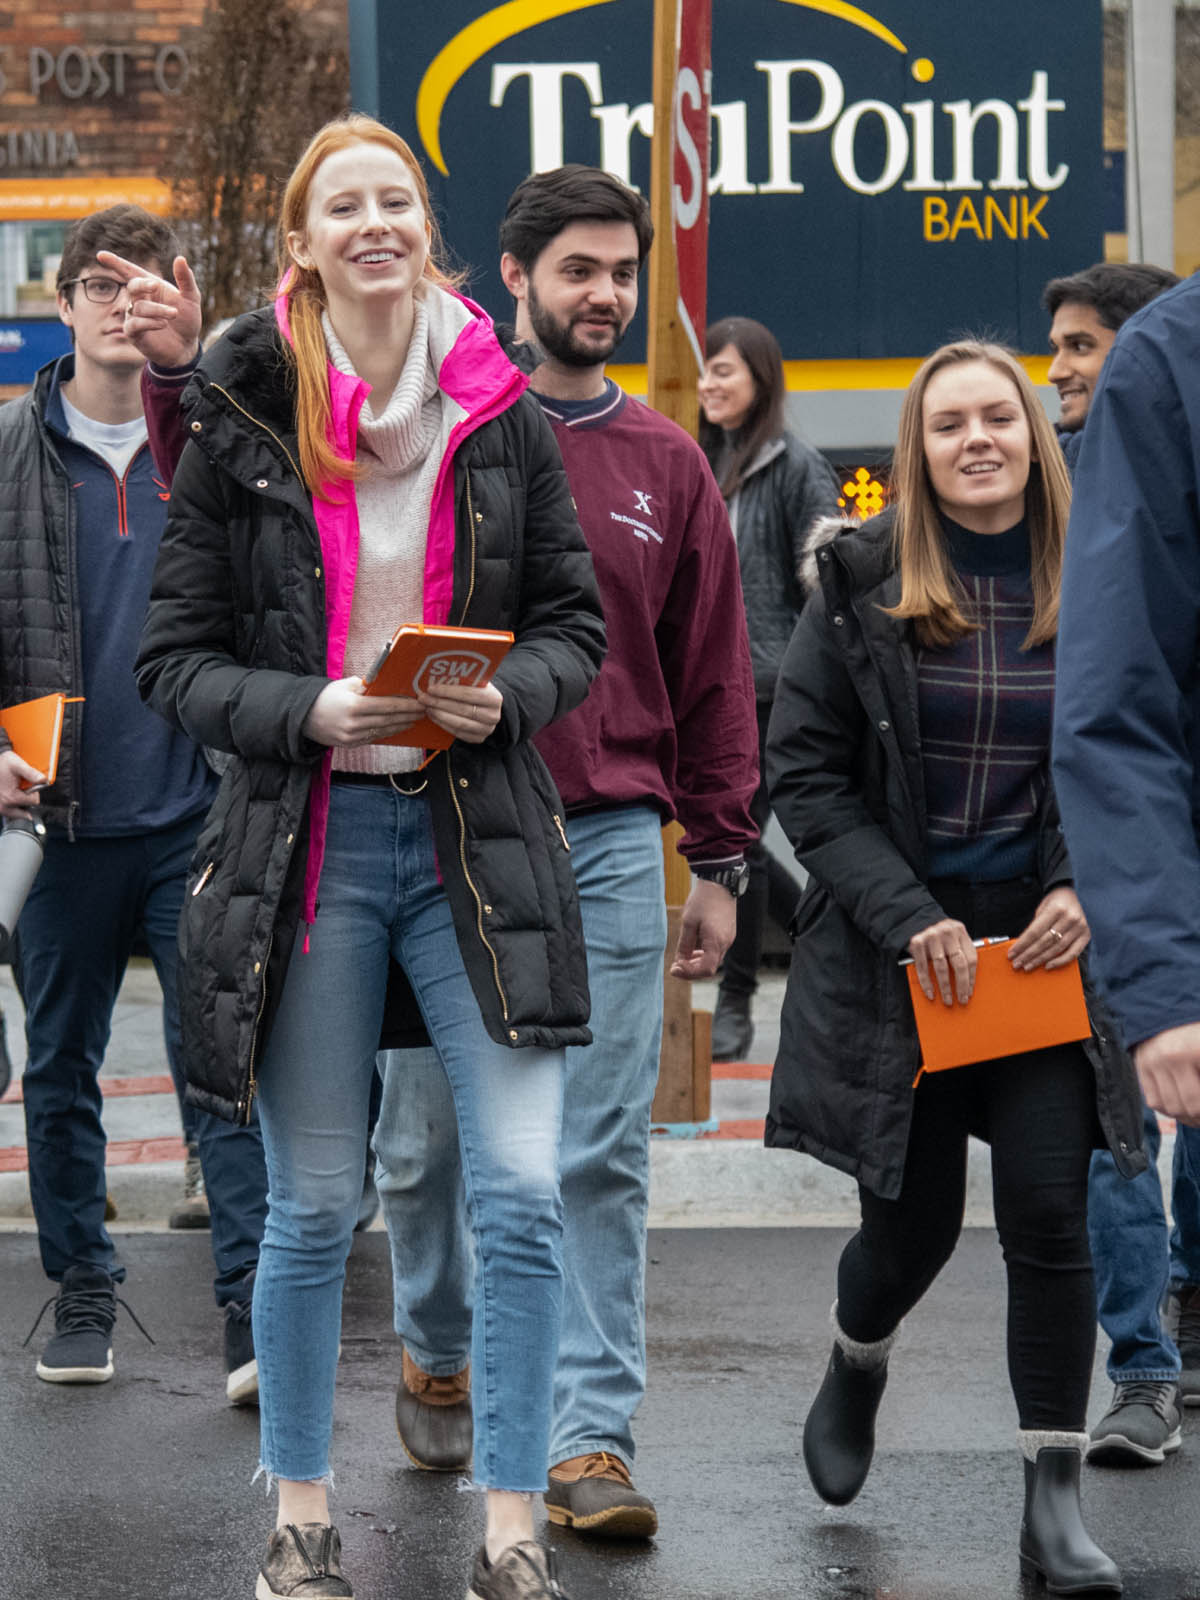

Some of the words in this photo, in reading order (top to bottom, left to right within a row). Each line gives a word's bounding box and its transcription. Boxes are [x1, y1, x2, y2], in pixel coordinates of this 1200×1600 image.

[29, 45, 128, 98] POST
[489, 57, 1070, 197] TruPoint
[923, 195, 1050, 242] BANK
[429, 658, 479, 678] SW
